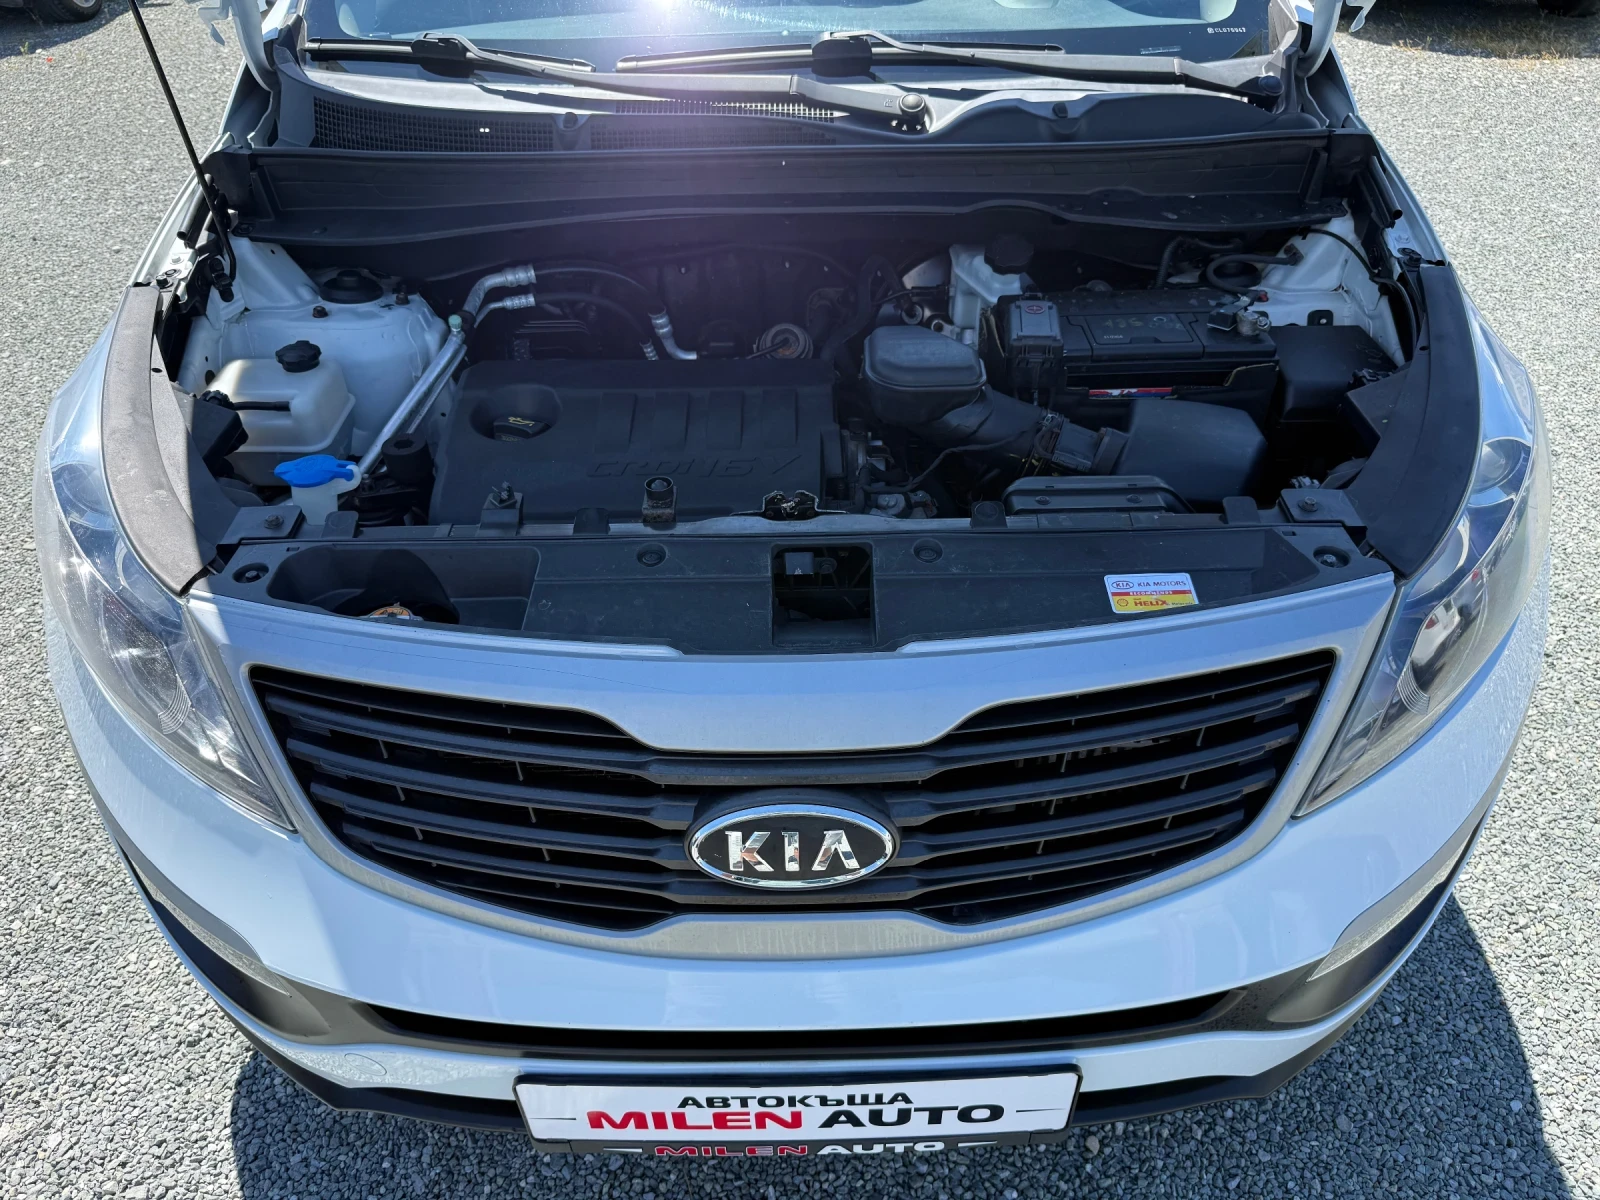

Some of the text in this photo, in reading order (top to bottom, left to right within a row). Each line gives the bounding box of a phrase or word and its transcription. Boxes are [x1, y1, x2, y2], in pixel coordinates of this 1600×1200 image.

[1133, 599, 1167, 607] HELIX
[725, 830, 860, 872] KIA
[587, 1104, 1006, 1130] MILEN AUTO
[654, 1141, 946, 1157] MILEN AUTO
